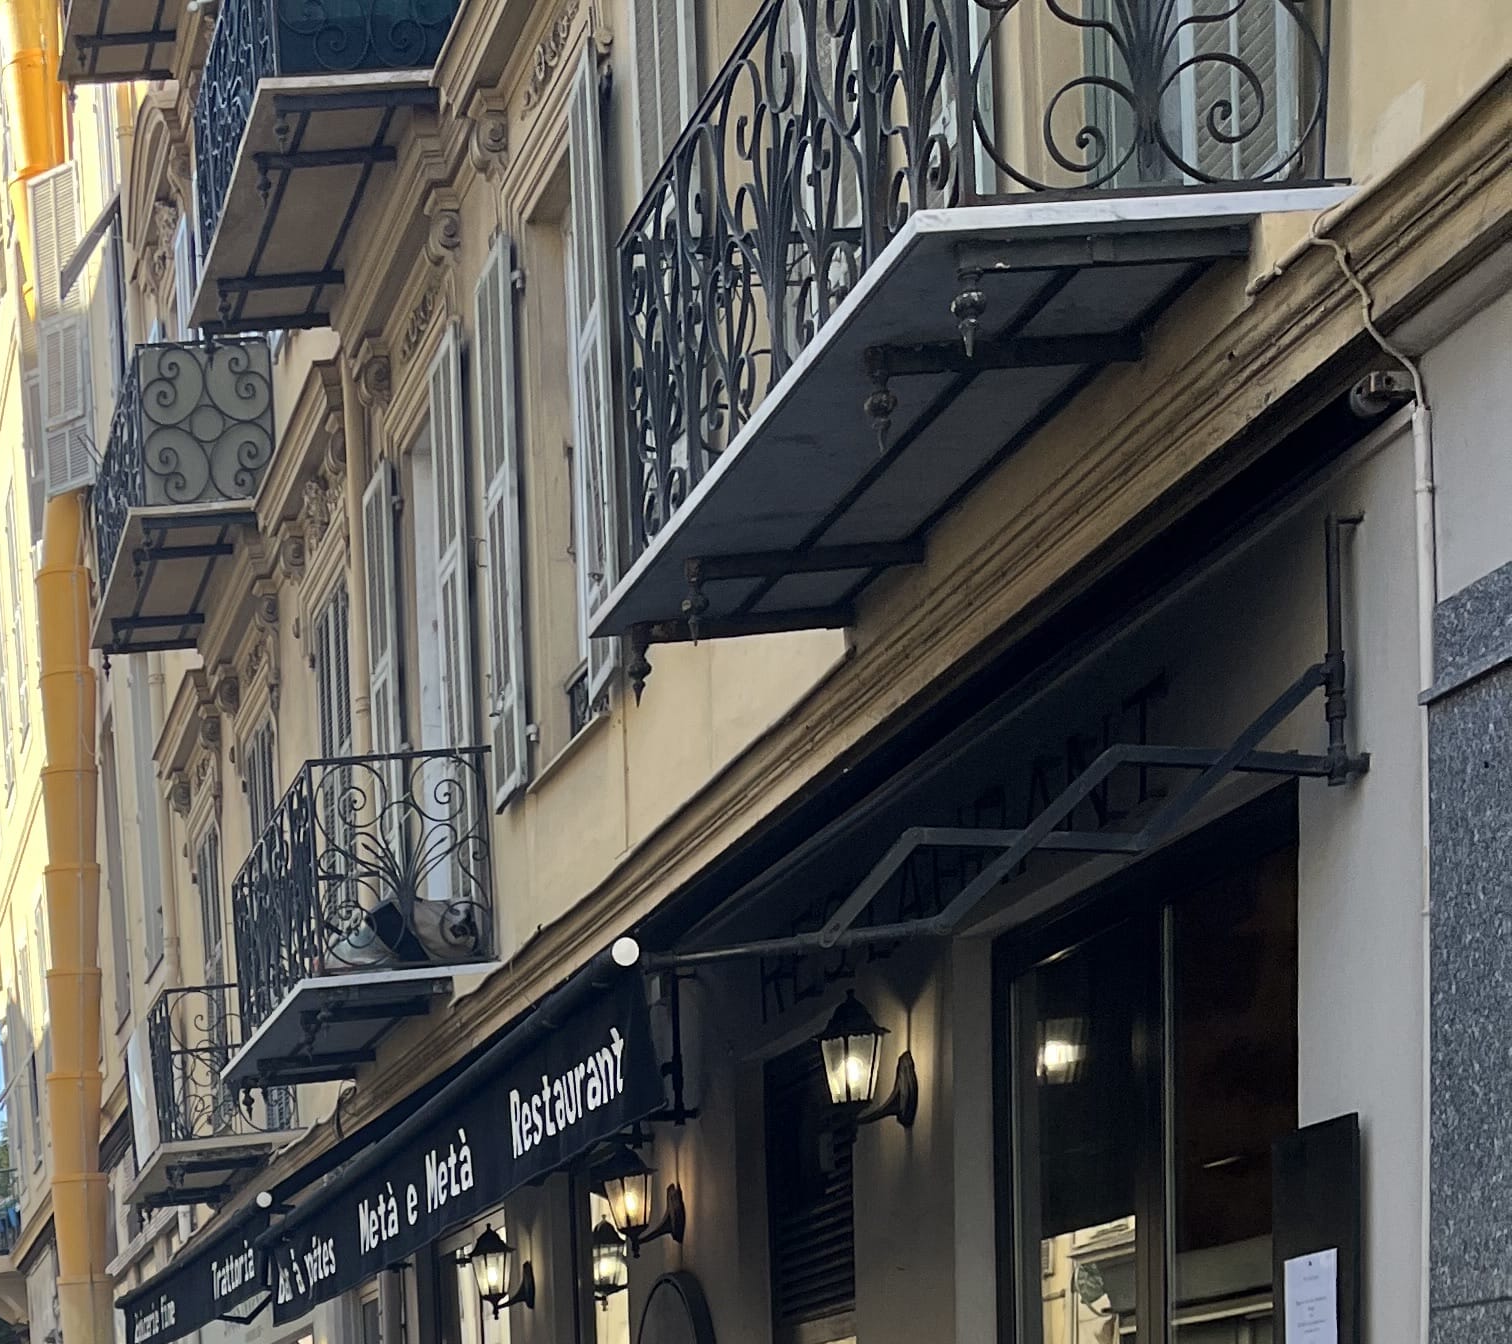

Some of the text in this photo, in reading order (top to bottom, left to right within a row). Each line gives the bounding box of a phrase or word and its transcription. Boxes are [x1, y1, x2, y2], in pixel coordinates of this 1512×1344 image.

[508, 1026, 625, 1160] Restaurant
[358, 1127, 475, 1256] Metà e Metà
[211, 1239, 256, 1301] Trattoria
